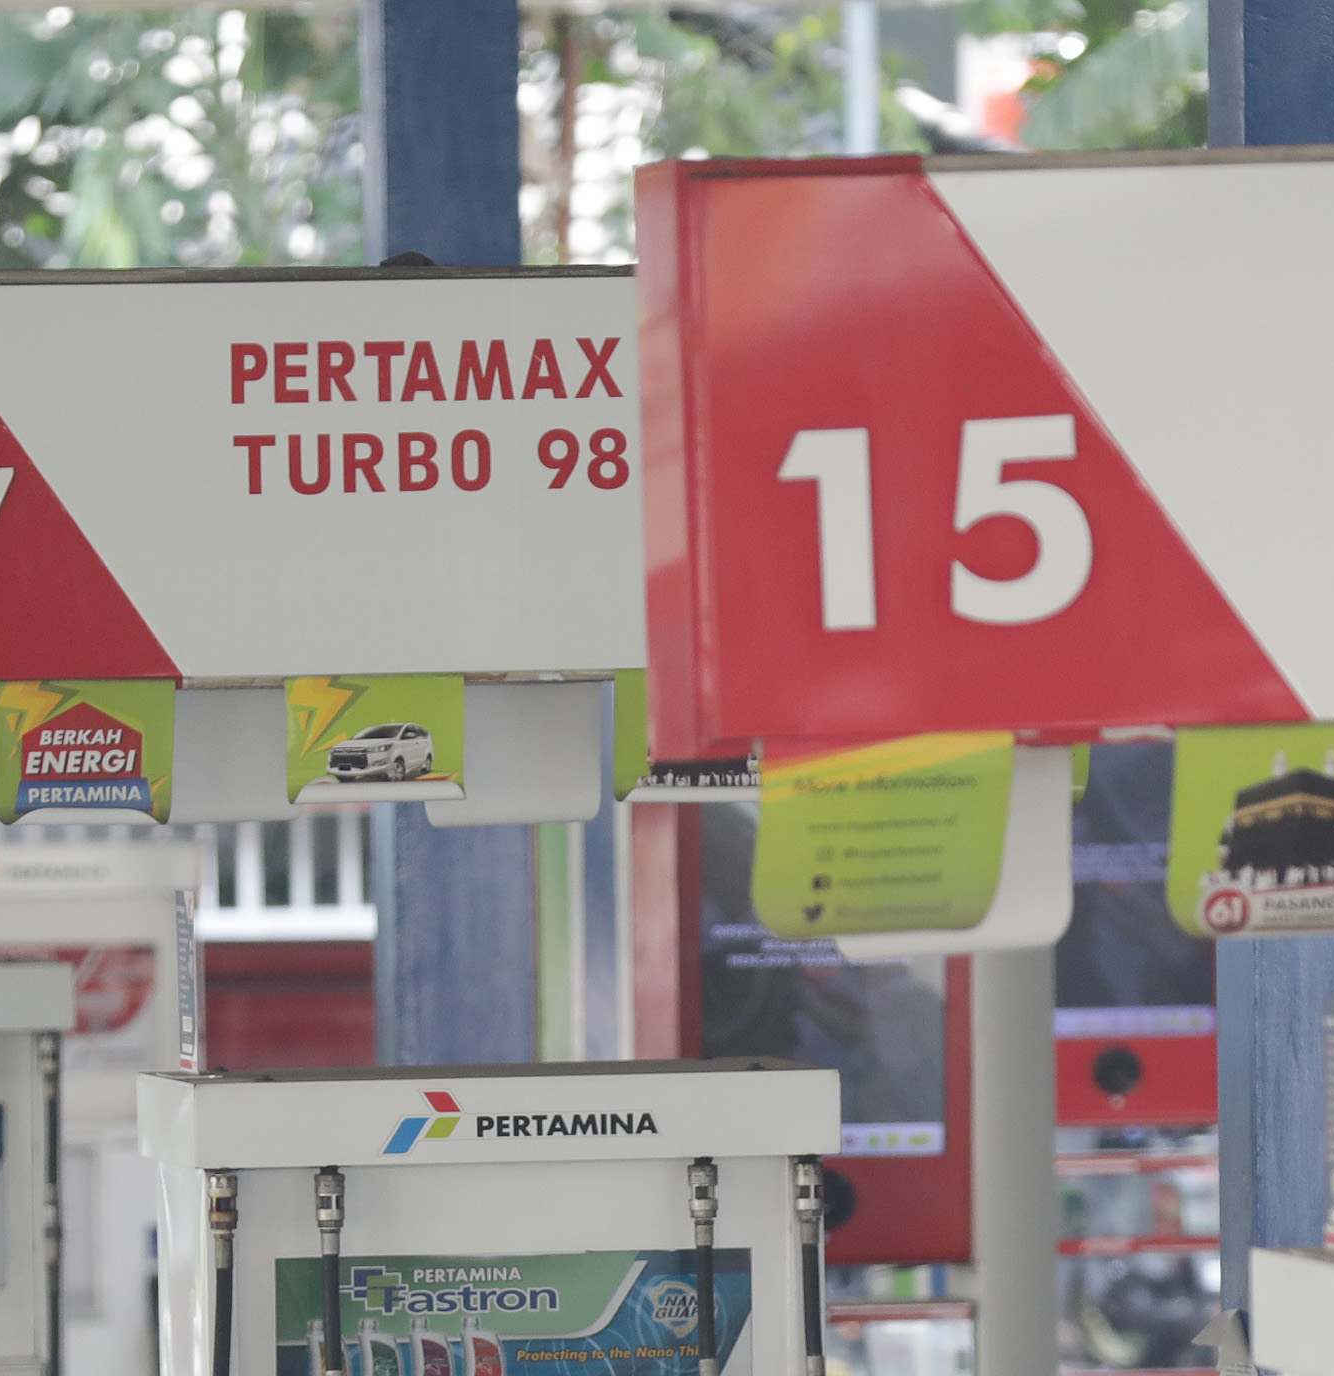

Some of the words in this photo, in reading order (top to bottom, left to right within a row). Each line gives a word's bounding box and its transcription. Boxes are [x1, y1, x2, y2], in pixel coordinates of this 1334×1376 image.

[230, 336, 624, 405] PERTAMAX
[232, 428, 493, 496] TURBO
[536, 426, 631, 491] 98
[776, 412, 1095, 633] 15
[39, 728, 123, 746] BERKAH
[25, 748, 137, 775] ENERGI
[28, 785, 143, 804] PERTAMINA
[474, 1110, 660, 1139] PERTAMINA
[412, 1266, 523, 1284] PERTAMINA
[381, 1284, 560, 1315] Fastron
[663, 1294, 699, 1308] NAN
[653, 1306, 699, 1320] GUAR
[516, 1347, 588, 1363] Protecting
[591, 1347, 606, 1360] to
[609, 1346, 632, 1359] the
[636, 1345, 674, 1359] Nano
[679, 1344, 700, 1357] Thi
